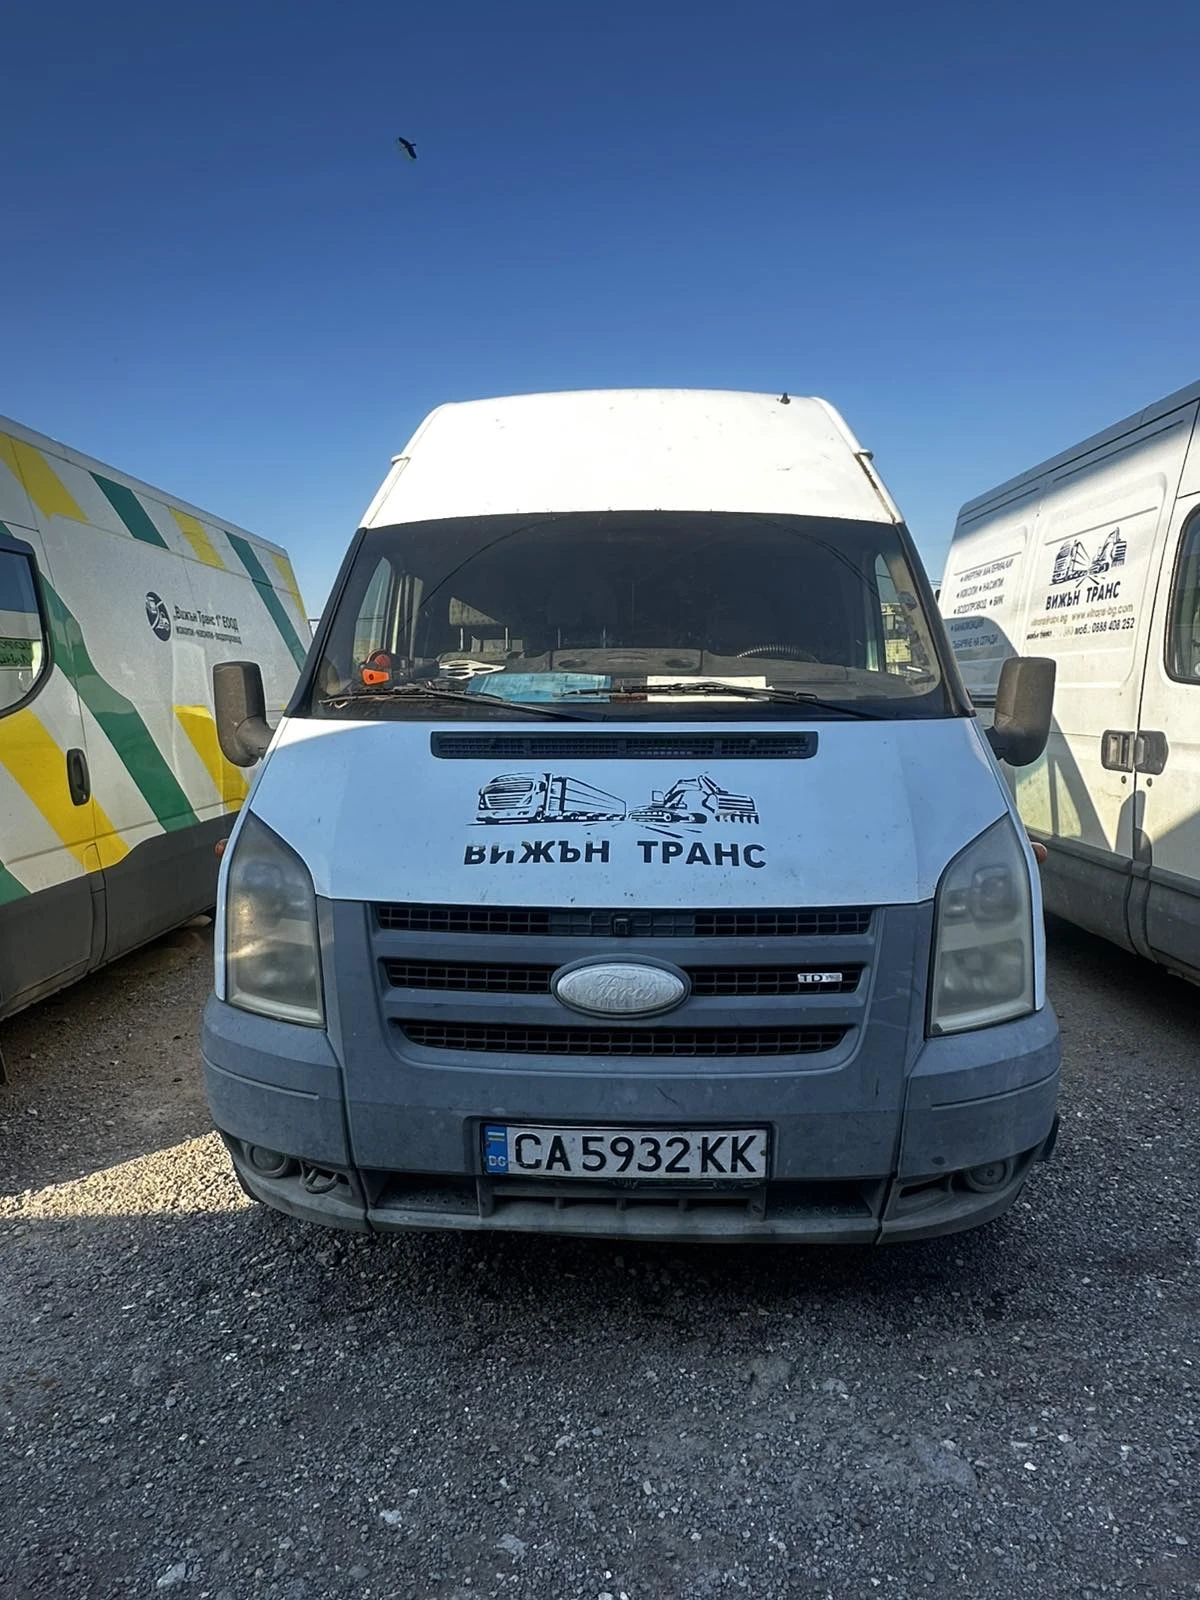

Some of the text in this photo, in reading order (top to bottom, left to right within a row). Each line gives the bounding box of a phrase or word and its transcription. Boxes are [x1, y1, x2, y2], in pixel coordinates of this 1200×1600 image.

[1086, 581, 1121, 603] ТРАНС
[1122, 617, 1136, 629] 252
[637, 840, 767, 868] ТРАНС
[588, 974, 657, 1004] Ford
